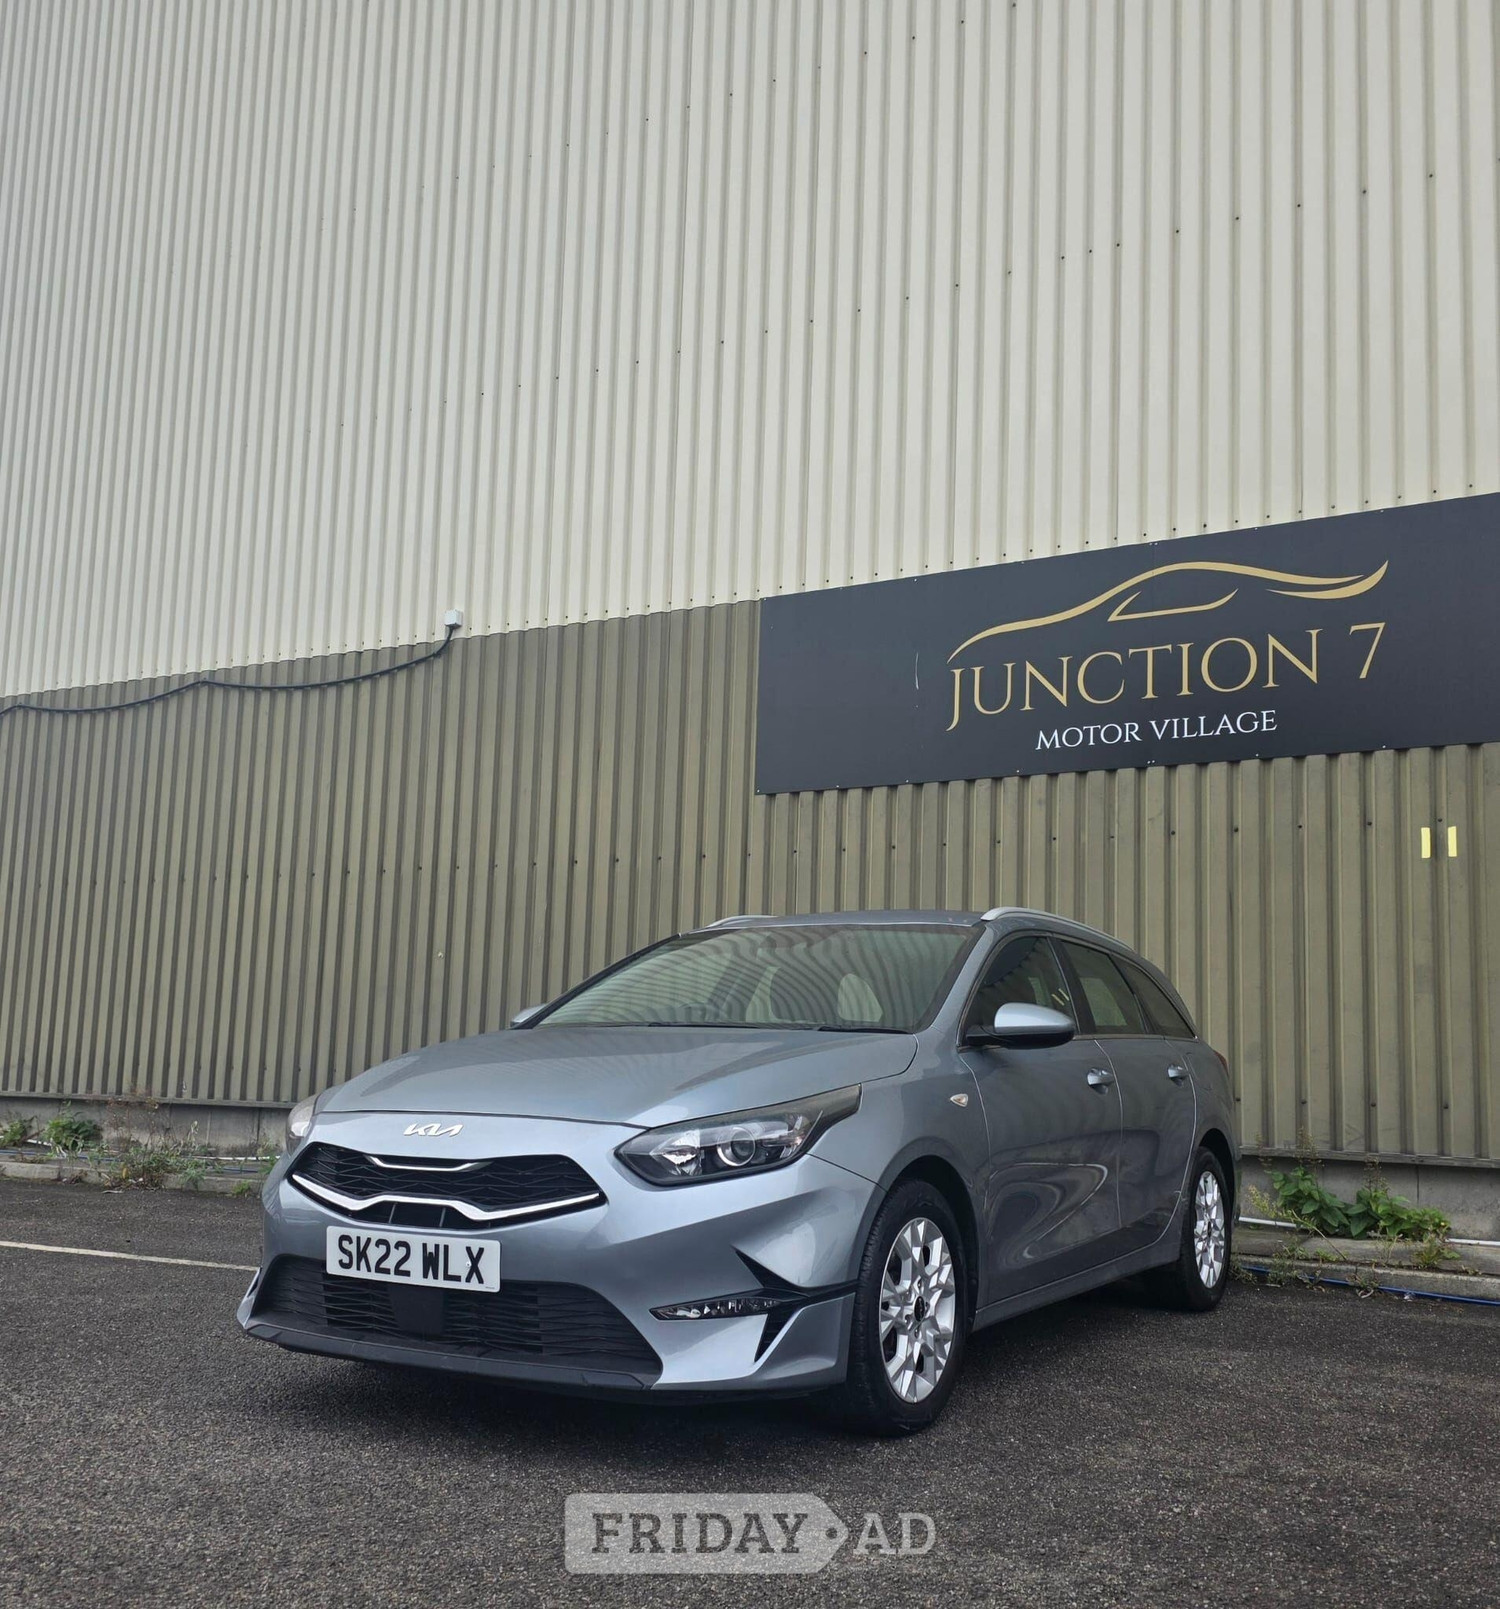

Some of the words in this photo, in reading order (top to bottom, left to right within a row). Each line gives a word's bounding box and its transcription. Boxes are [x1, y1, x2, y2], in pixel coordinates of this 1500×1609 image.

[946, 630, 1323, 731] JUNCTION
[1349, 622, 1386, 679] 7
[1036, 722, 1142, 751] MOTOR
[1150, 710, 1278, 742] VILLAGE
[403, 1123, 464, 1137] KIA
[338, 1234, 411, 1277] SK22
[422, 1242, 484, 1284] WLX
